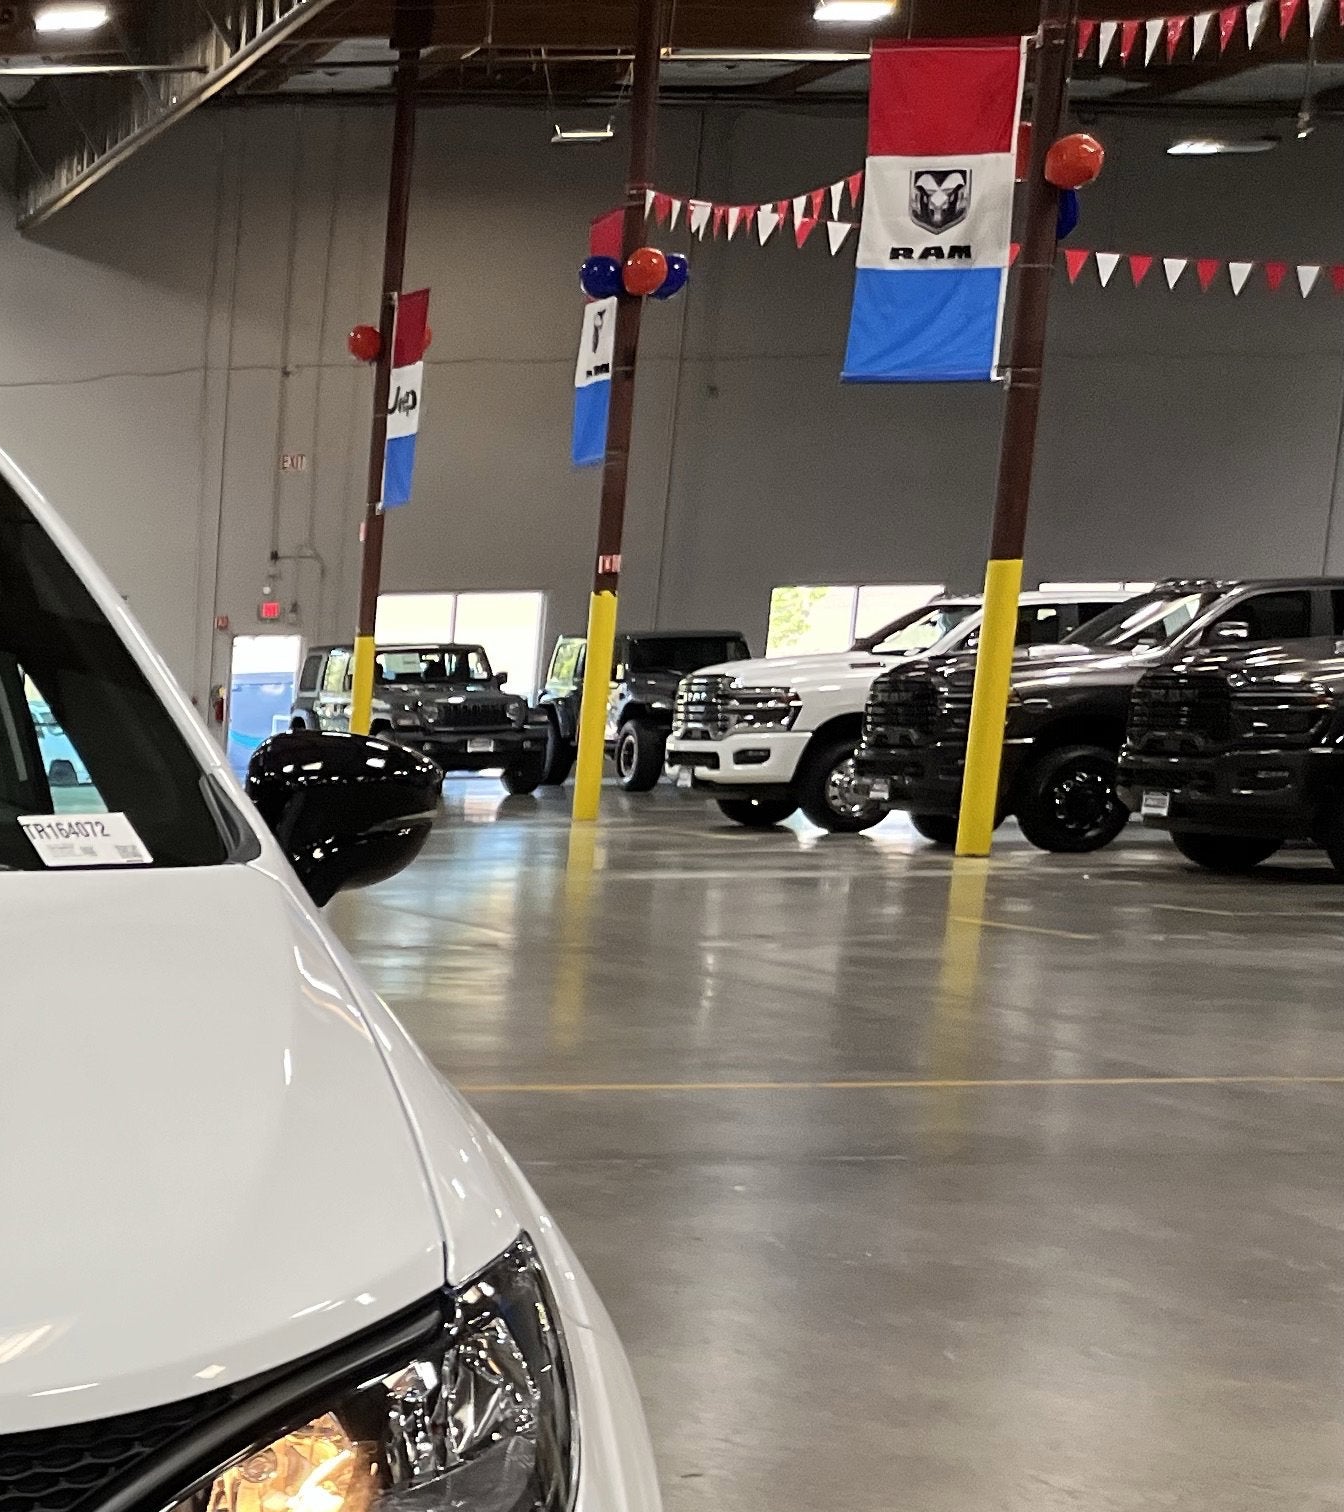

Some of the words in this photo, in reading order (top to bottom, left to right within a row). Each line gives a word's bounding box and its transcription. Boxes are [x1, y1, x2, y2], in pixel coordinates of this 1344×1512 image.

[889, 245, 972, 260] RAM
[387, 386, 417, 416] Jp
[281, 454, 306, 470] EXIT
[23, 821, 111, 840] TR164072
